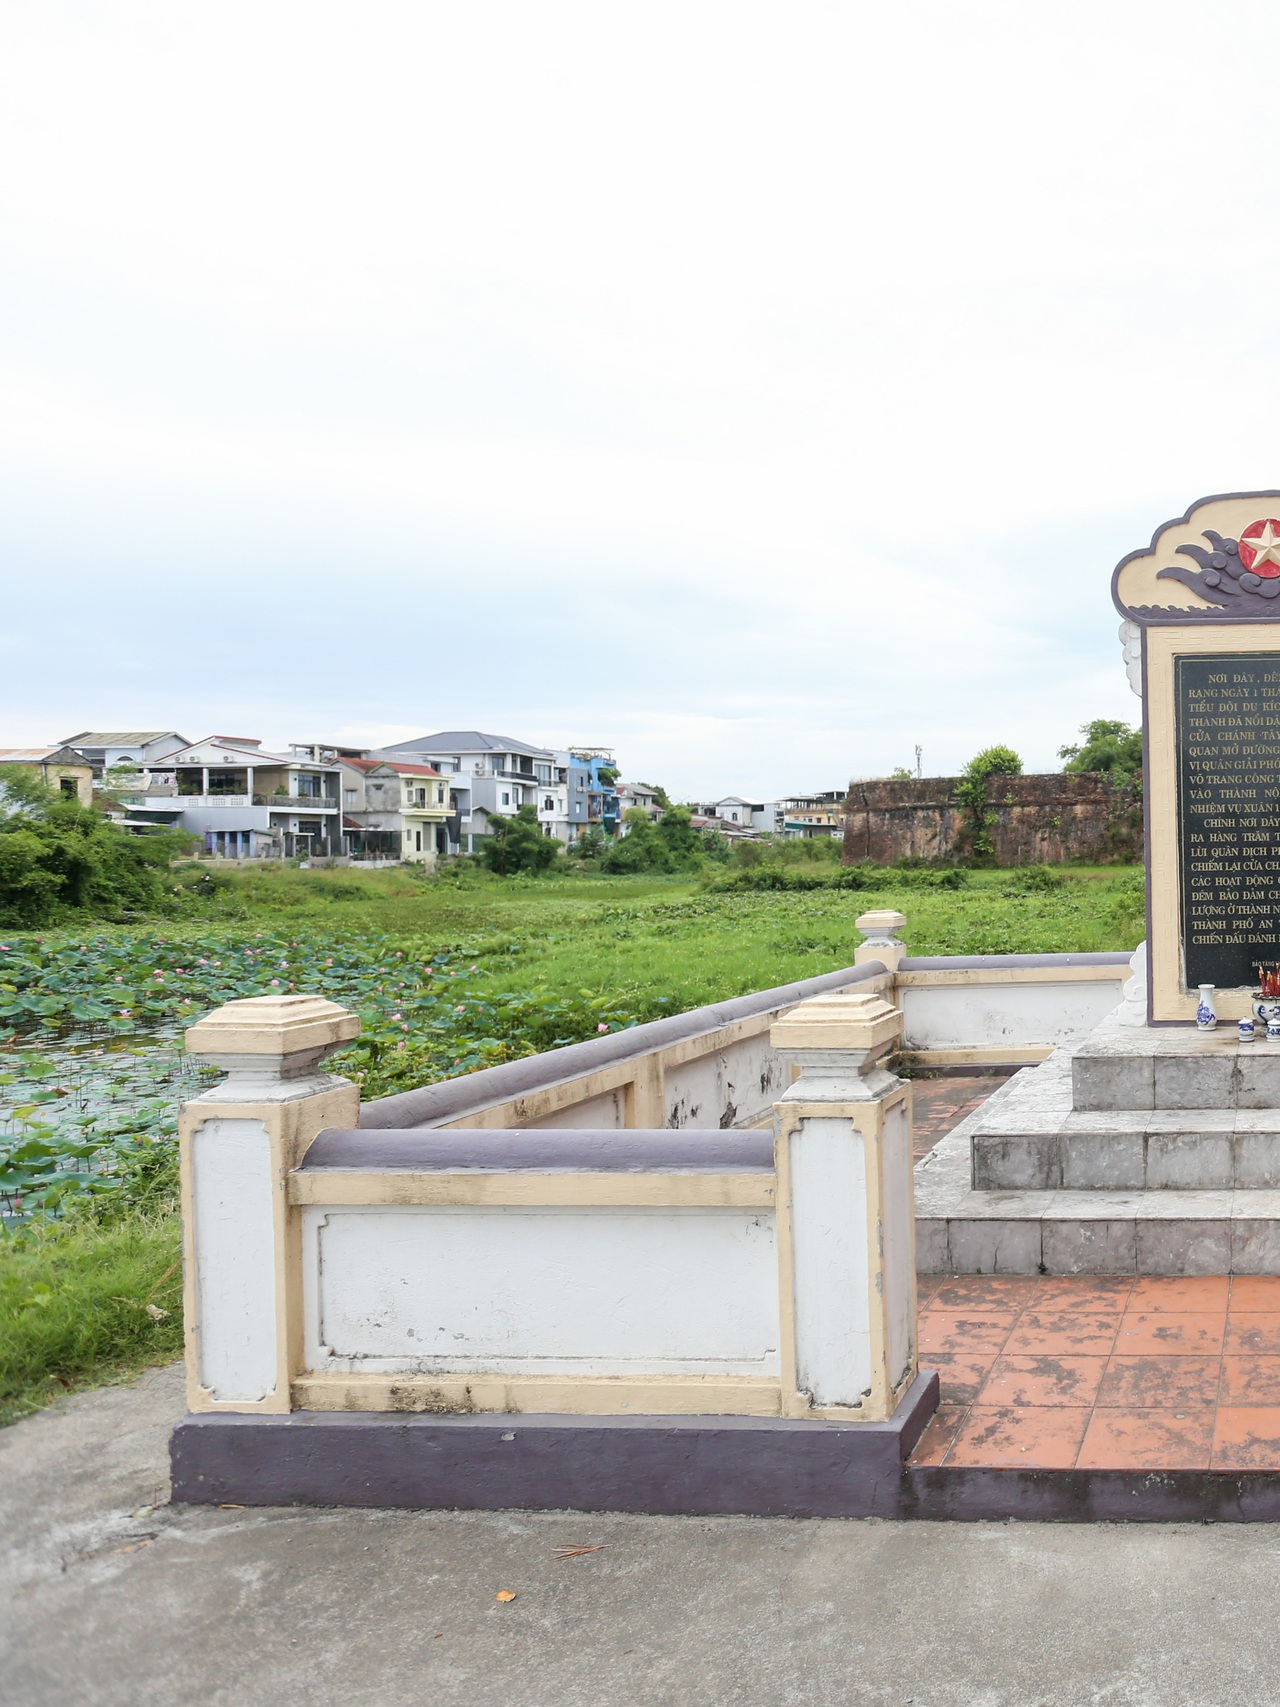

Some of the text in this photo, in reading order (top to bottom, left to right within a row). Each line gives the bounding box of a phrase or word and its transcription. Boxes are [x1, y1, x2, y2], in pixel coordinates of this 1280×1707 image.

[1209, 674, 1228, 683] NƠI
[1188, 689, 1218, 699] RẠNG
[1221, 686, 1250, 697] NGÀY
[1188, 700, 1214, 712] TIỂU
[1219, 701, 1237, 713] ĐỘI
[1243, 703, 1257, 711] DU
[1189, 716, 1225, 726] THÀNH
[1228, 715, 1242, 726] ĐÃ
[1245, 714, 1264, 726] NỔI
[1189, 729, 1210, 741] CỬA
[1218, 730, 1255, 740] CHÁNH
[1189, 747, 1218, 757] QUAN
[1222, 743, 1239, 755] MỞ
[1243, 744, 1280, 755] ĐƯỜNG
[1189, 761, 1200, 771] VỊ
[1202, 759, 1232, 771] QUÂN
[1234, 757, 1257, 769] GIẢI
[1189, 774, 1204, 784] VÕ
[1206, 775, 1242, 784] TRANG
[1245, 773, 1274, 783] CÔNG
[1190, 788, 1211, 798] VÀO
[1219, 787, 1256, 798] THÀNH
[1190, 802, 1225, 815] NHIỆM
[1227, 804, 1241, 814] VỤ
[1244, 802, 1273, 812] XUÂN
[1204, 817, 1235, 827] CHÍNH
[1240, 818, 1257, 827] NƠI
[1191, 834, 1204, 842] RA
[1210, 831, 1237, 842] HÀNG
[1242, 831, 1269, 841] TRĂM
[1191, 846, 1207, 857] LÙI
[1211, 846, 1238, 858] QUÂN
[1243, 847, 1267, 858] ĐỊCH
[1191, 859, 1223, 871] CHIẾM
[1225, 862, 1241, 872] LẠI
[1243, 859, 1263, 870] CỬA
[1191, 875, 1211, 886] CÁC
[1215, 877, 1242, 887] HOẠT
[1246, 874, 1273, 887] ĐỘNG
[1192, 890, 1213, 900] ĐÊM
[1219, 888, 1239, 900] BẢO
[1243, 888, 1264, 900] ĐẢM
[1192, 905, 1225, 917] LƯỢNG
[1228, 903, 1235, 914] Ở
[1236, 903, 1270, 914] THÀNH
[1192, 919, 1226, 929] THÀNH
[1232, 916, 1254, 929] PHỐ
[1259, 920, 1273, 928] AN
[1192, 931, 1223, 944] CHIẾN
[1225, 931, 1246, 944] ĐẤU
[1248, 932, 1275, 942] ĐÁNH
